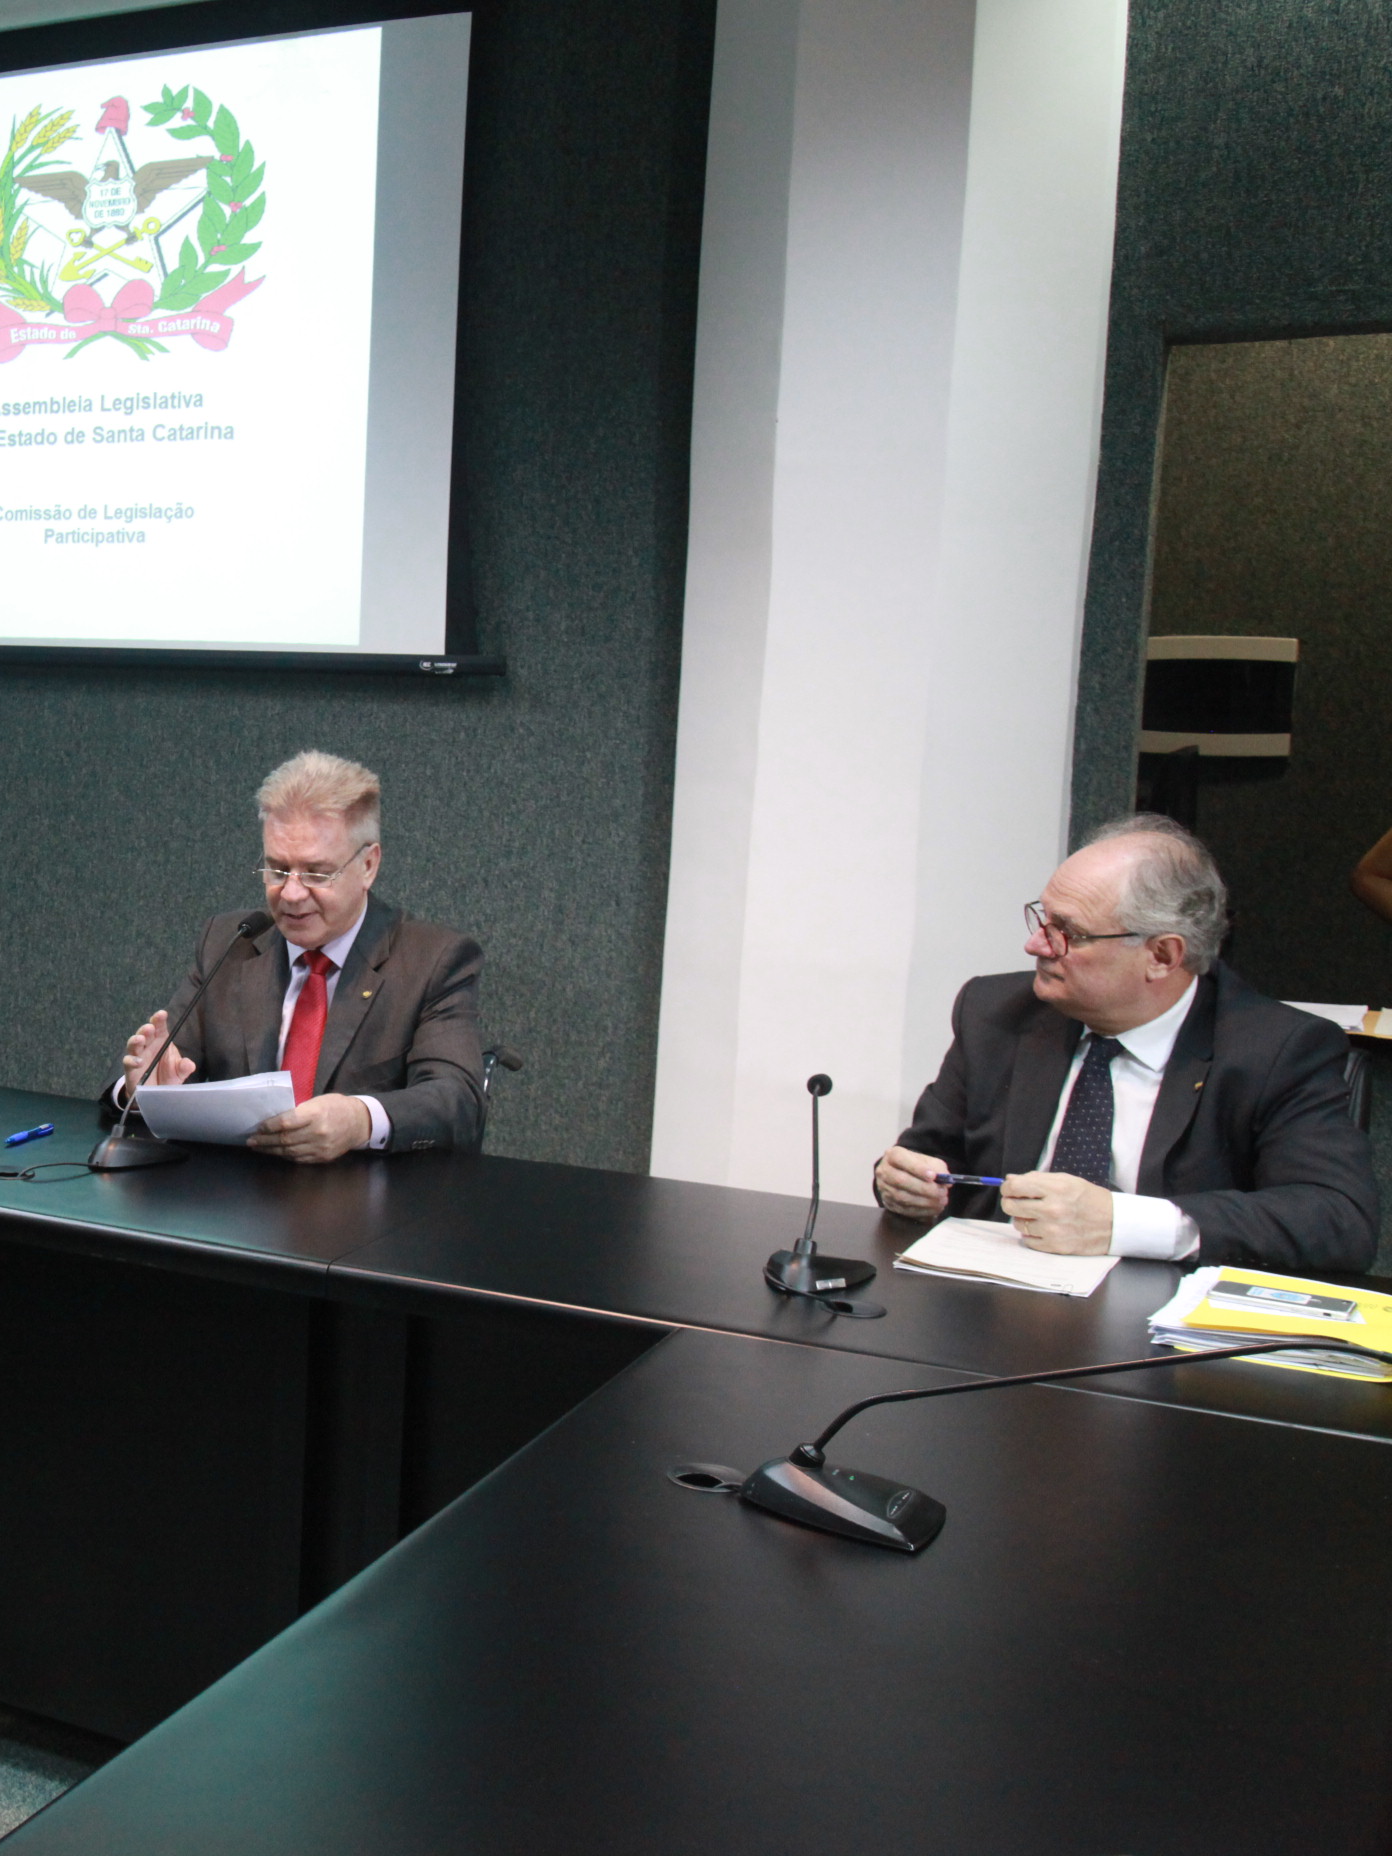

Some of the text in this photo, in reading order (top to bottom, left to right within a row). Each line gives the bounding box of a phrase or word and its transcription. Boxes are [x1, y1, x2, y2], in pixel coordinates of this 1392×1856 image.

[111, 187, 121, 196] DE
[94, 210, 104, 218] DE
[10, 316, 221, 344] Estado de Sta. Catarina
[100, 391, 204, 416] Legislativa
[64, 427, 86, 445] de
[92, 425, 146, 444] Santa
[152, 421, 235, 442] Catarina
[77, 504, 98, 521] de
[103, 502, 195, 523] Legislação
[43, 527, 146, 548] Participativa
